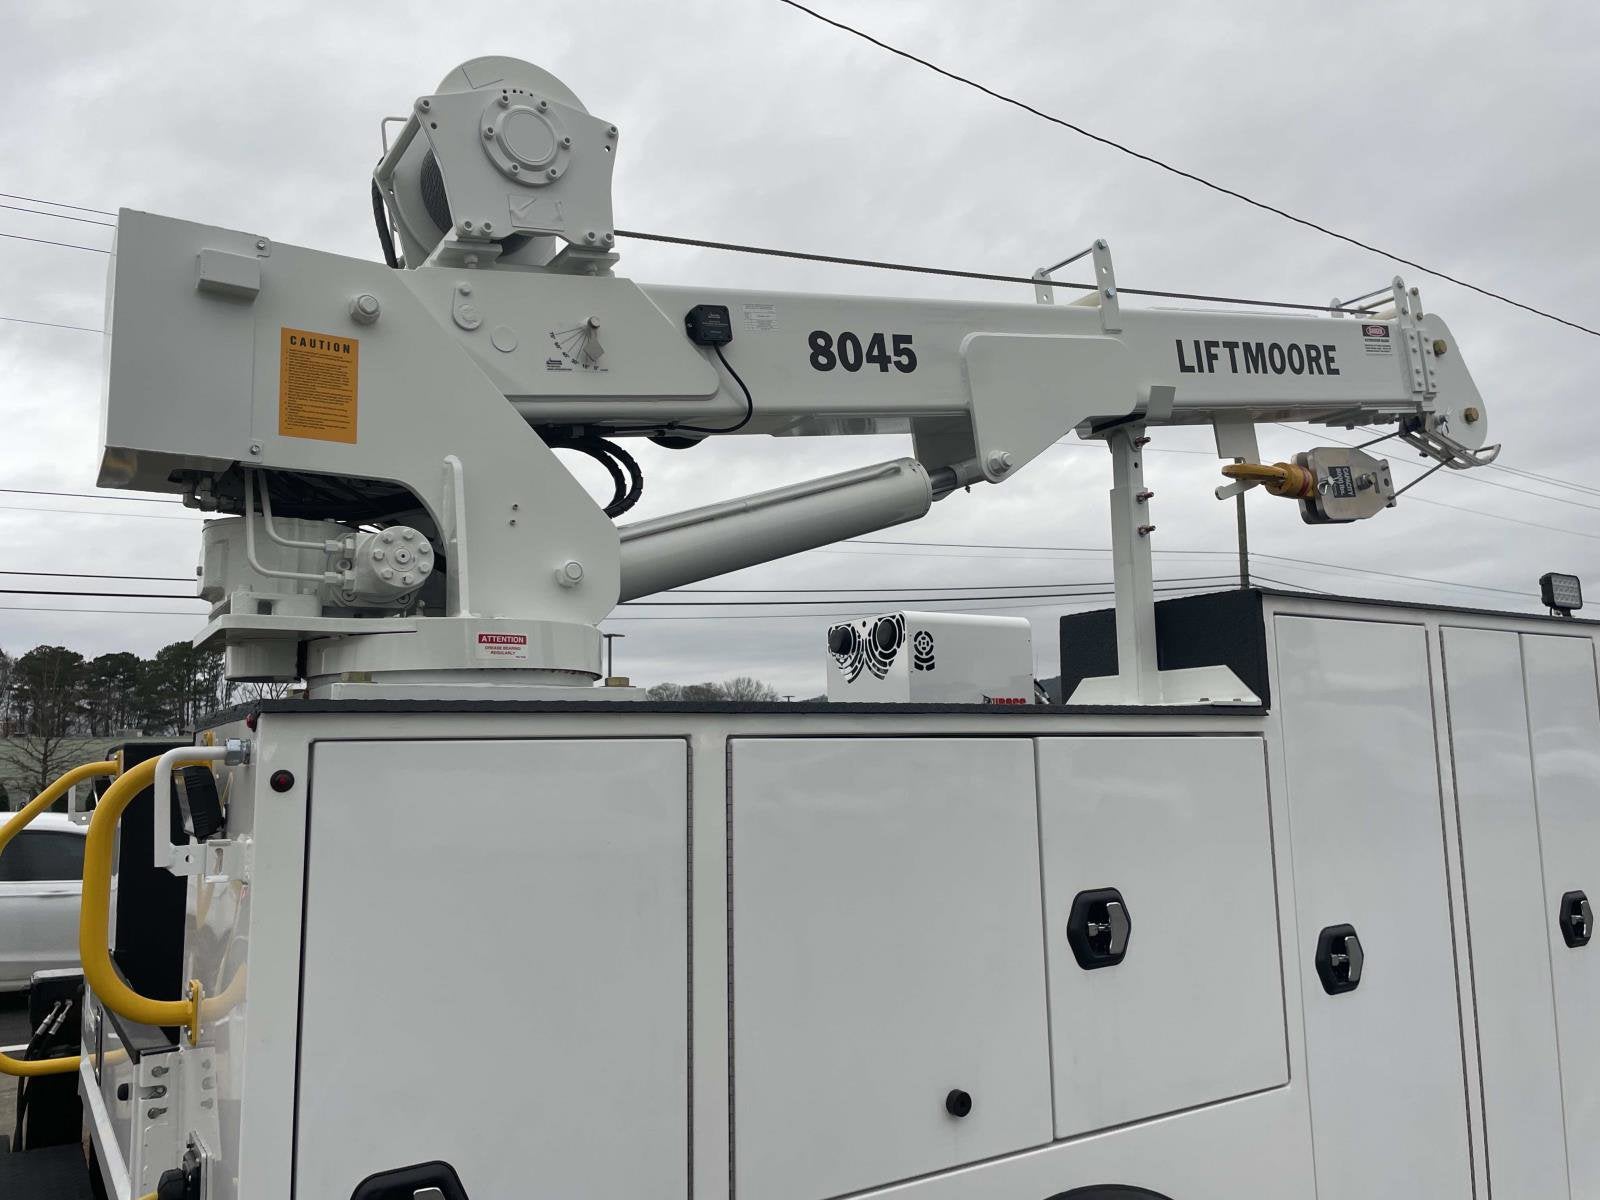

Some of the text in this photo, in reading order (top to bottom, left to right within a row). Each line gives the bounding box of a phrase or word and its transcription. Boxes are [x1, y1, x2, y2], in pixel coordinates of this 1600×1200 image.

[290, 335, 350, 354] CAUTION
[808, 330, 918, 374] 8045
[1175, 339, 1341, 376] LIFTMOORE
[1342, 467, 1354, 496] CAPACITY
[481, 635, 524, 643] ATTENTION
